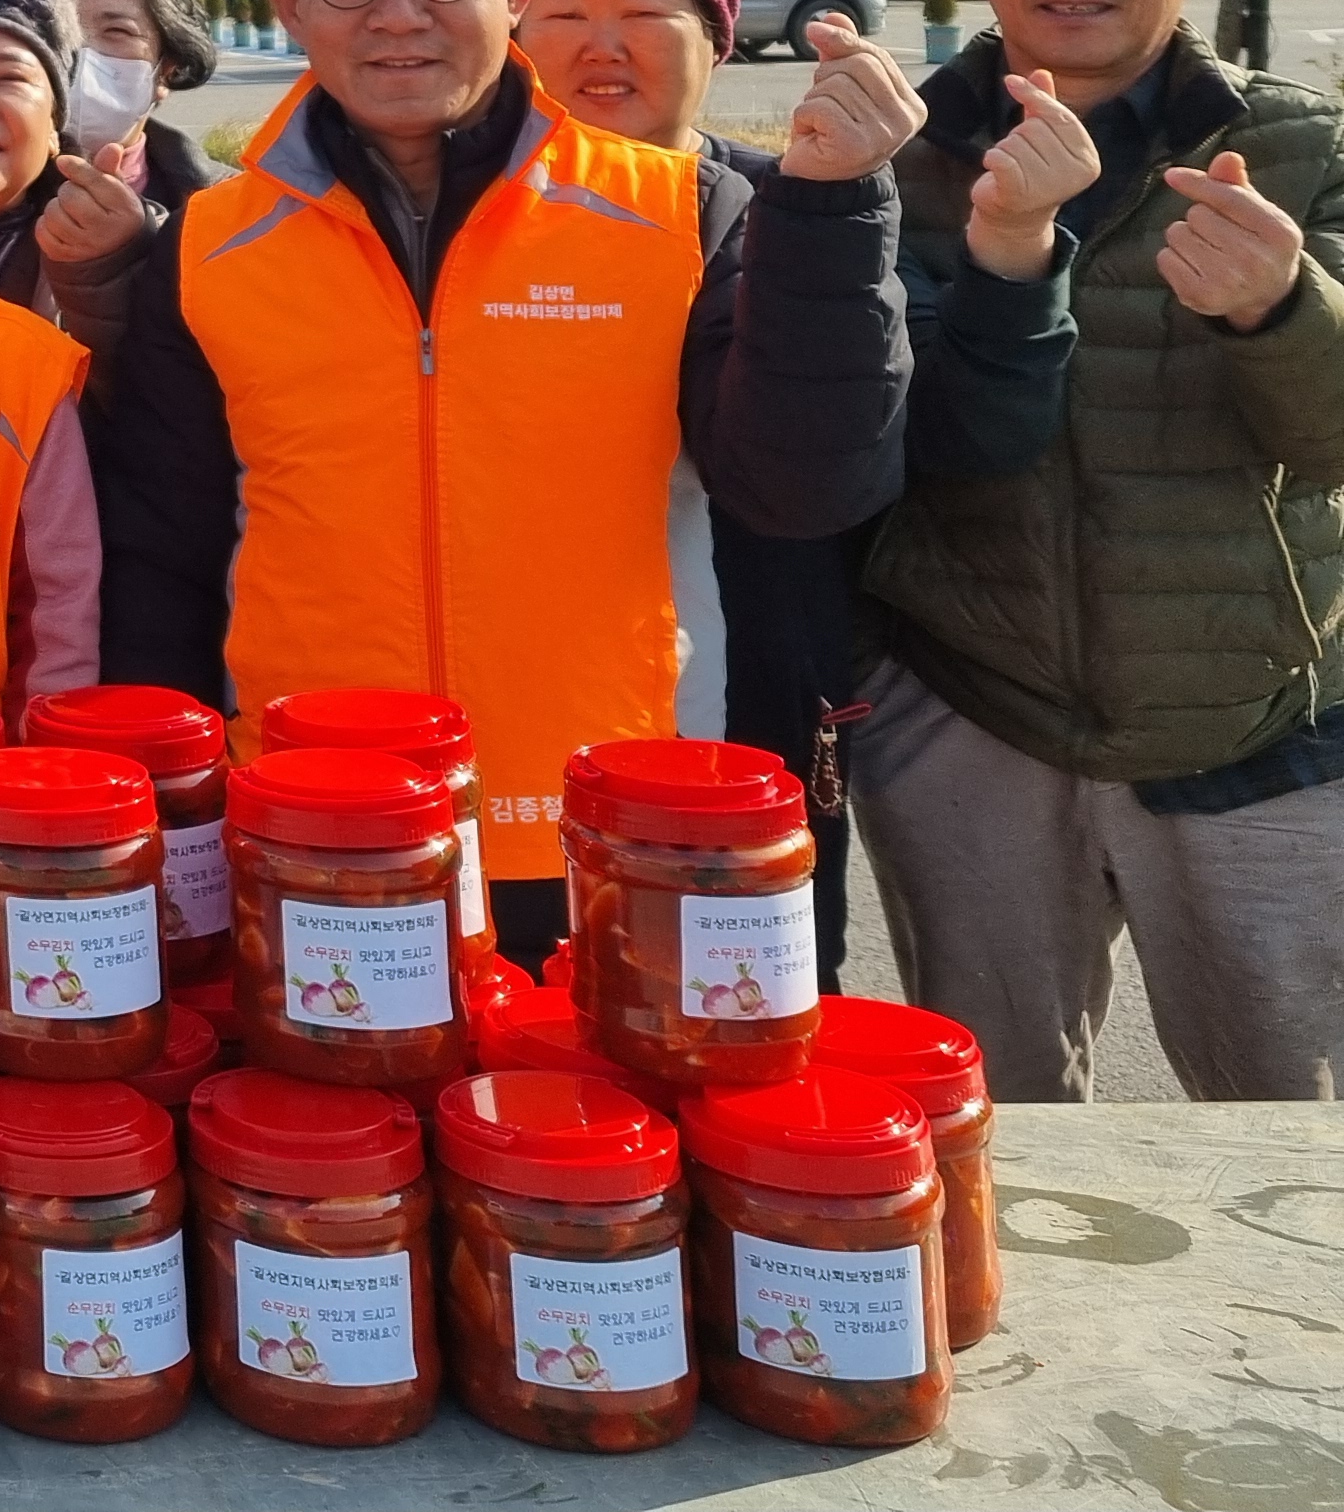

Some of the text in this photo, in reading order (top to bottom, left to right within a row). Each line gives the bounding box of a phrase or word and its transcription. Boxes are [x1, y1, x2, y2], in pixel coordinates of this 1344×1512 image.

[529, 284, 575, 301] 길상면
[483, 302, 623, 320] 지역사회보장협의체
[488, 794, 562, 823] 김종철
[27, 930, 145, 952] 순무김치 맛있게 드시고
[94, 950, 141, 968] 건강하세요
[304, 946, 431, 962] 순무김치 맛있게 드시고
[708, 948, 756, 959] 순무김치
[373, 966, 427, 981] 건강하세요
[68, 1302, 115, 1315] 순무김치
[122, 1297, 153, 1314] 맛있게
[758, 1289, 902, 1314] 순무김치 맛있게 드시고
[261, 1300, 396, 1323] 순무김치 맛있게 드시고
[538, 1304, 669, 1327] 순무김치 맛있게 드시고
[332, 1327, 391, 1342] 건강하세요
[613, 1325, 666, 1346] 건강하세요
[835, 1321, 898, 1333] 건강하세요
